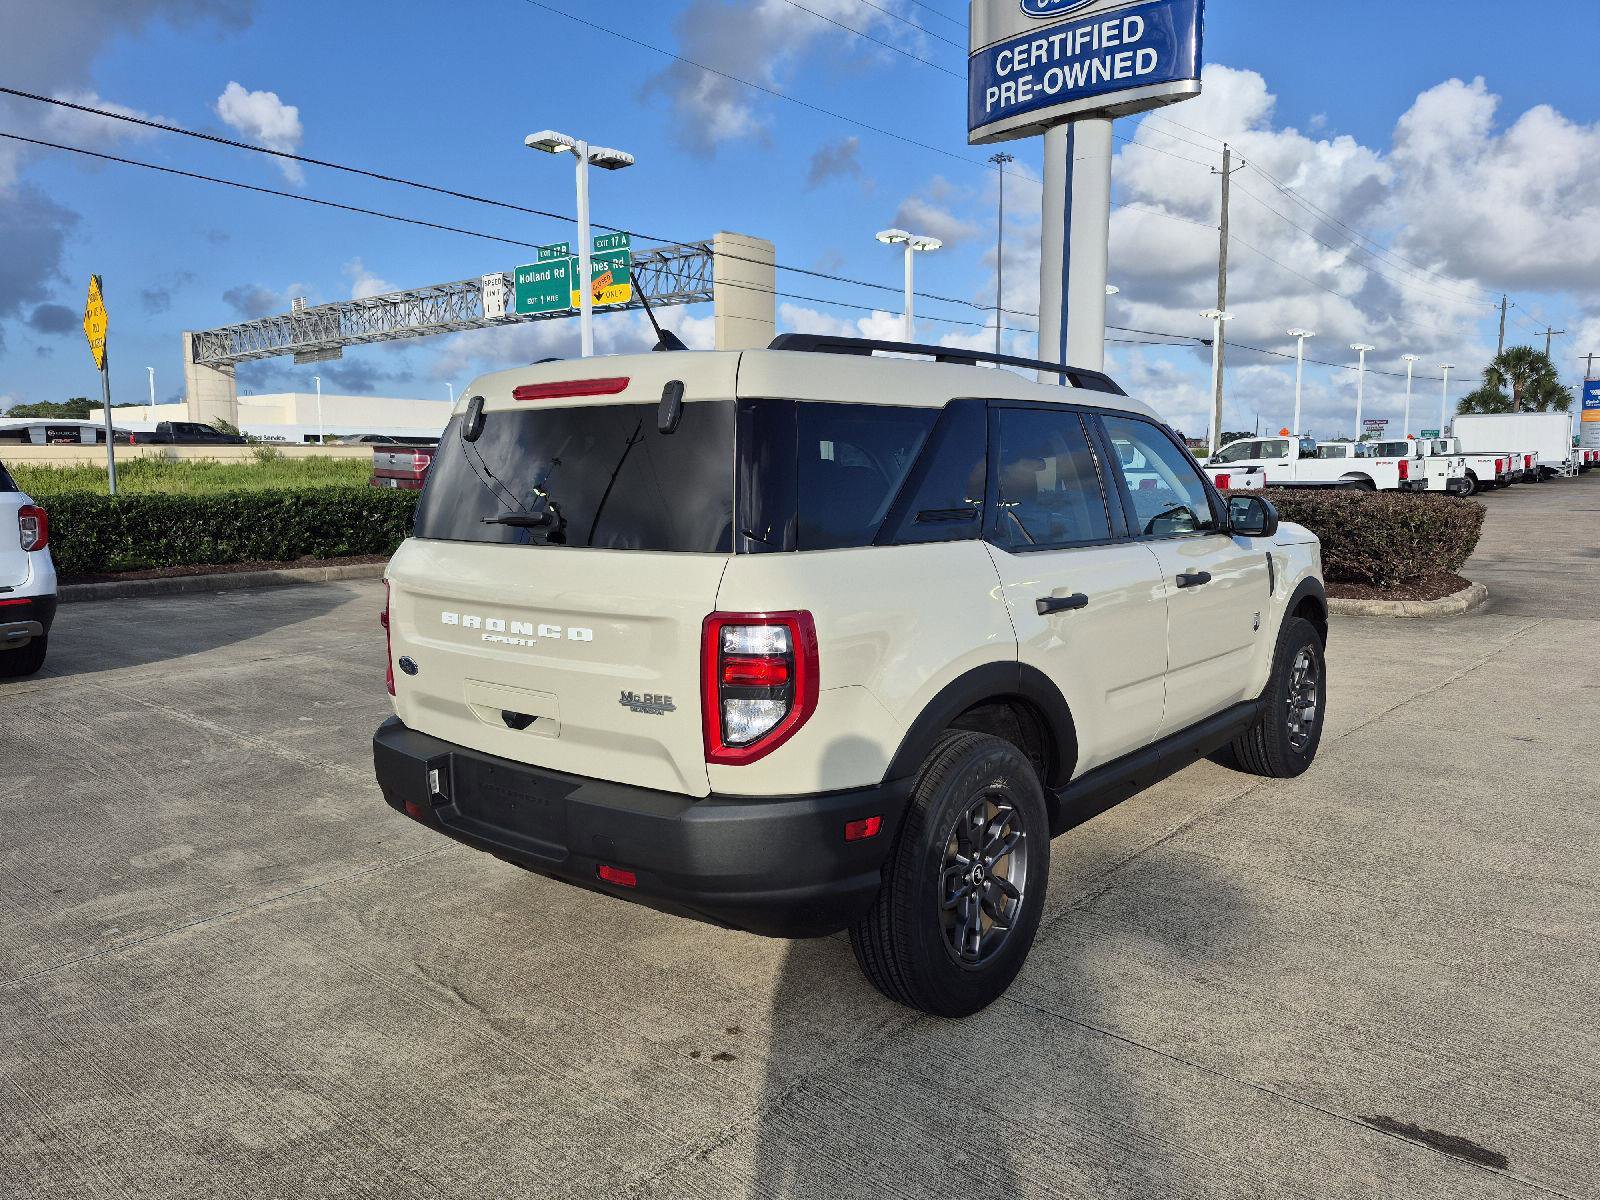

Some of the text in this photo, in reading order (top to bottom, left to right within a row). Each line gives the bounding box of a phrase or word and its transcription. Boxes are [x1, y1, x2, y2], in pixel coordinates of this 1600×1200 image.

[996, 15, 1145, 77] CERTIFIED
[985, 47, 1158, 113] PRE-OWNED
[596, 235, 627, 248] EXIT 17 A
[576, 256, 624, 274] Hhes Rd
[484, 278, 501, 287] SPEED
[519, 267, 565, 284] Holland Rd
[540, 295, 544, 304] 1
[546, 294, 559, 303] MILE
[605, 289, 623, 298] ONLY
[441, 611, 593, 642] BRONCO
[481, 633, 537, 647] SPORT
